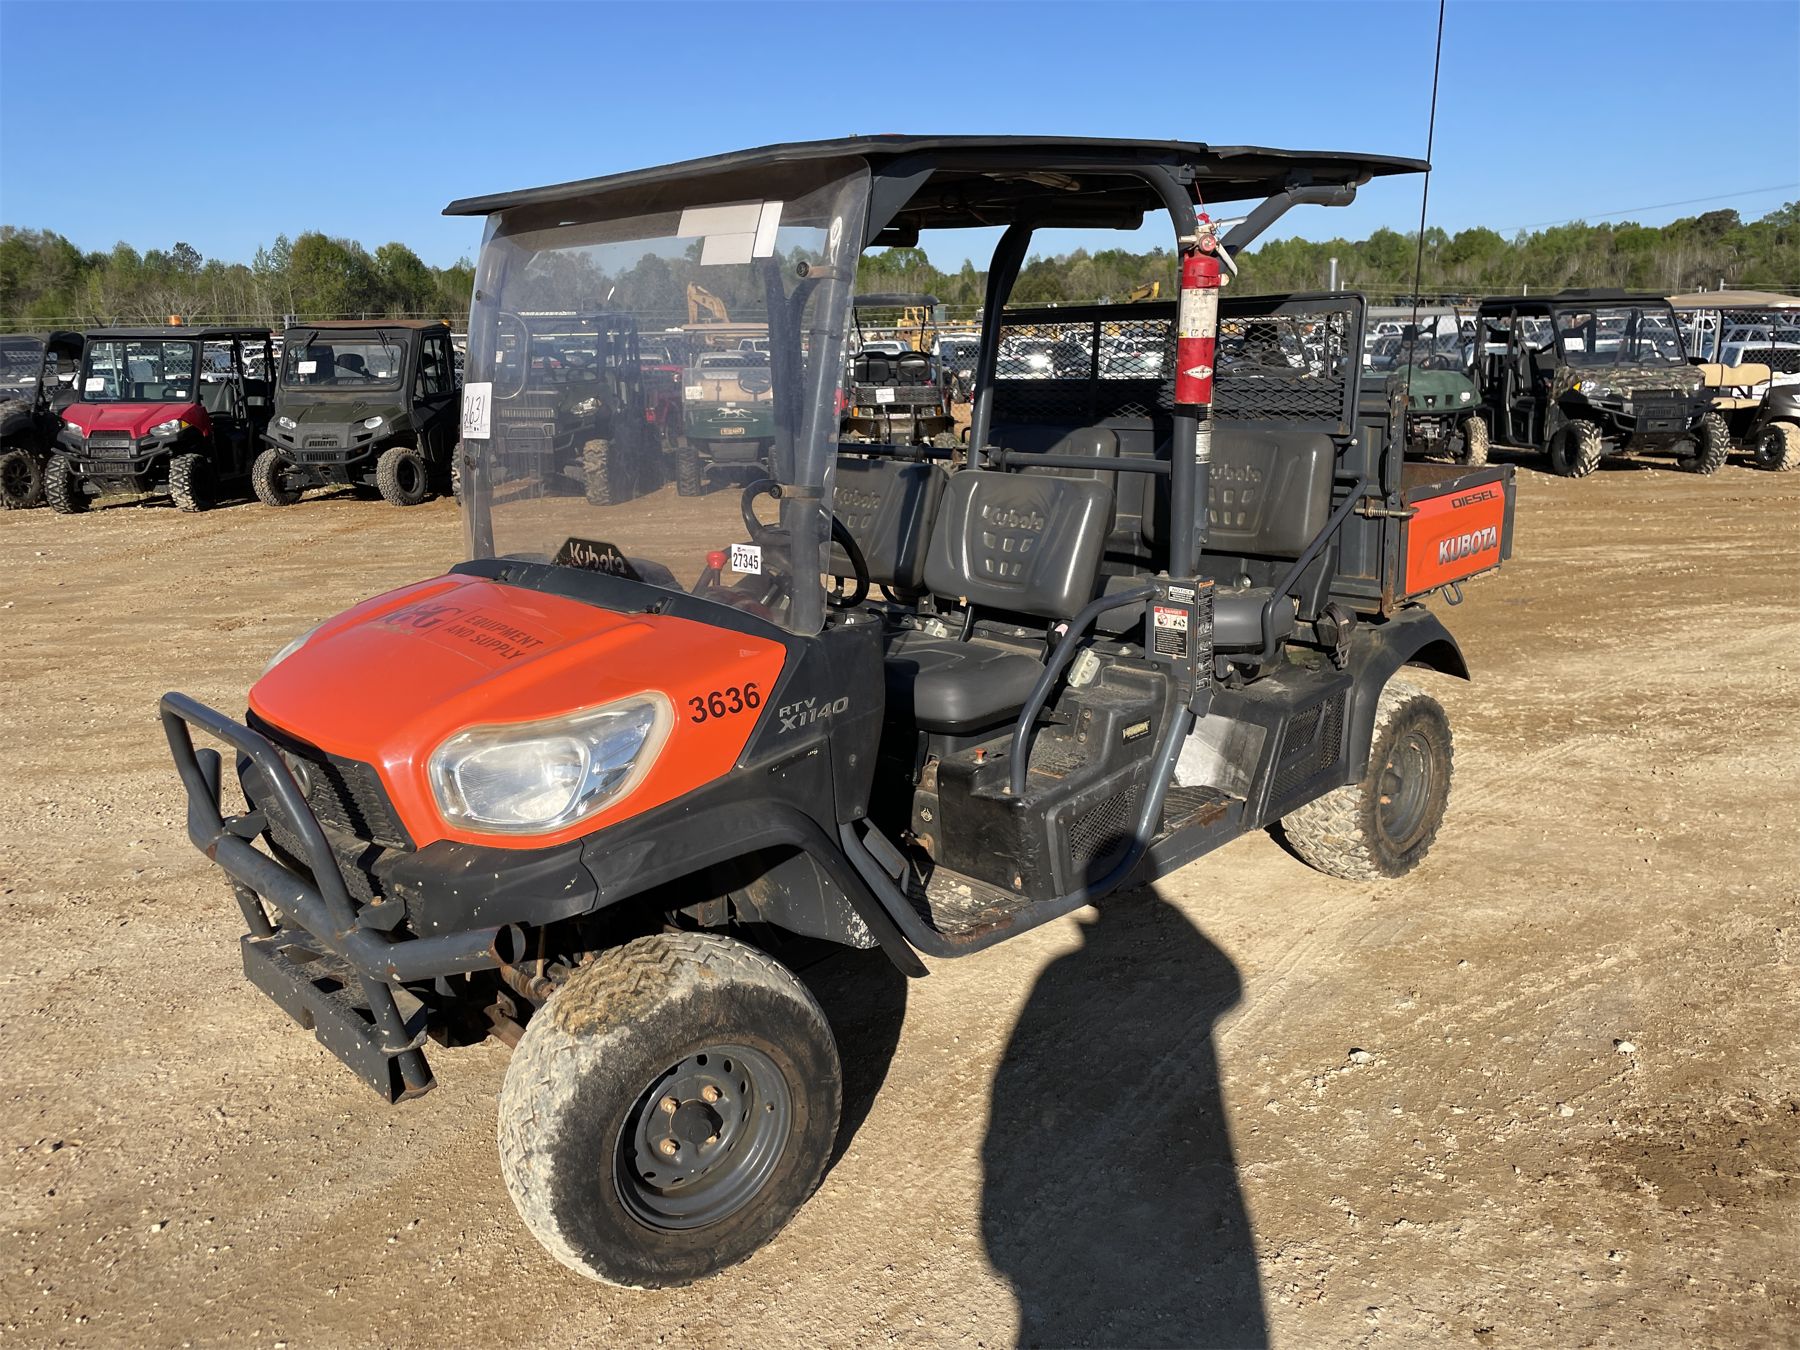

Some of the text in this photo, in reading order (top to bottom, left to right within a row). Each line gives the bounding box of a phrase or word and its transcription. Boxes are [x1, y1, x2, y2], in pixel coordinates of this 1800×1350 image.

[1451, 489, 1498, 509] DIESEL
[981, 504, 1045, 532] Kubota
[569, 542, 626, 574] Kubota
[733, 552, 759, 570] 27345
[1439, 526, 1497, 565] KUBOTA
[444, 624, 525, 660] AND SUPPLY
[465, 615, 544, 649] EQUIPMENT
[688, 682, 761, 724] 3636
[778, 696, 850, 734] X1140
[779, 697, 816, 718] RTV
